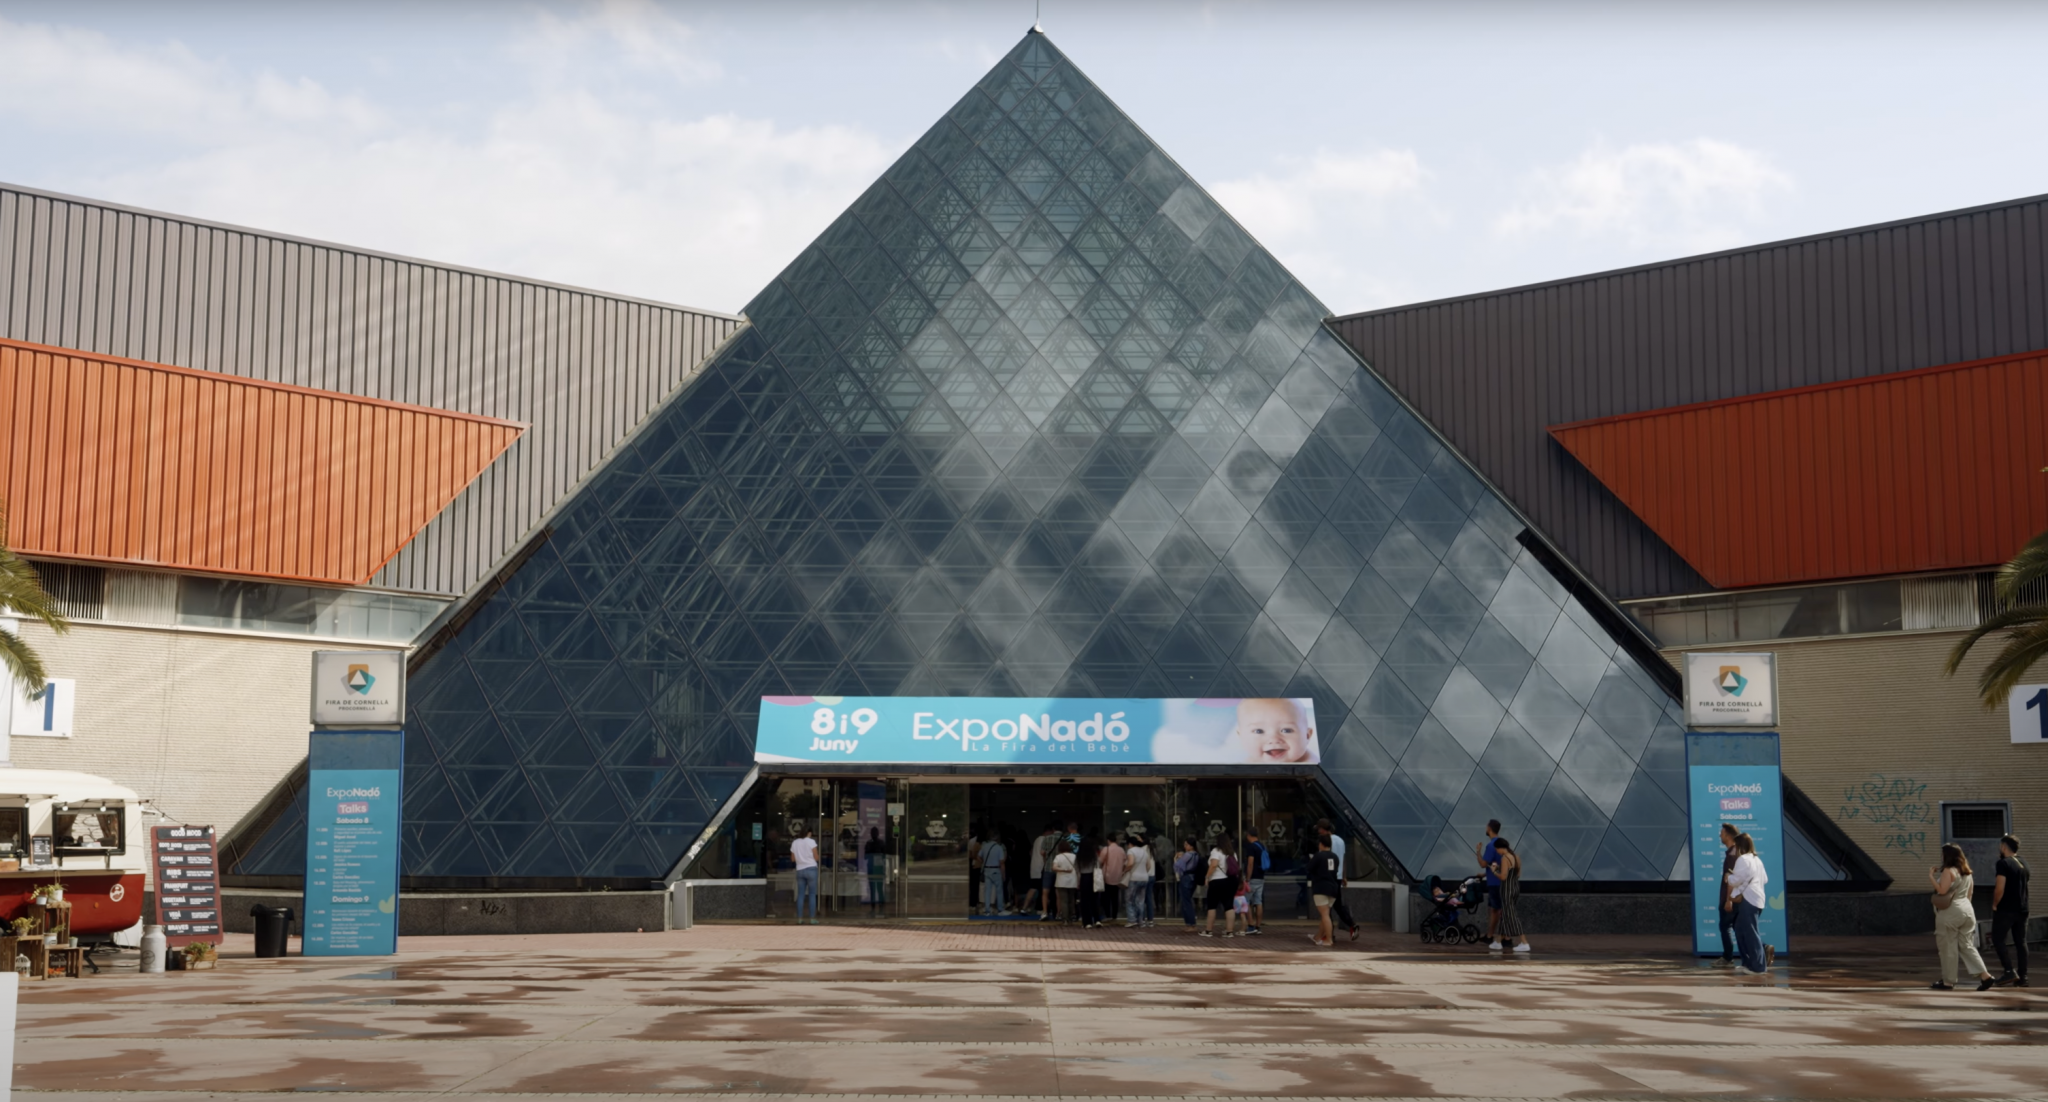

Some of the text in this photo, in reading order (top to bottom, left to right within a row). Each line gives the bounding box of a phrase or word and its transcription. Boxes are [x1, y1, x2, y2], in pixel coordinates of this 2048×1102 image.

[912, 711, 1130, 752] ExpoNadó
[809, 737, 859, 754] Juny
[972, 742, 1130, 752] La Fira del Bebè
[326, 786, 380, 800] ExpoNadó
[1708, 783, 1762, 796] ExpoNadó
[339, 804, 367, 814] Talks
[1722, 800, 1750, 810] Talks
[332, 896, 362, 904] Domingo
